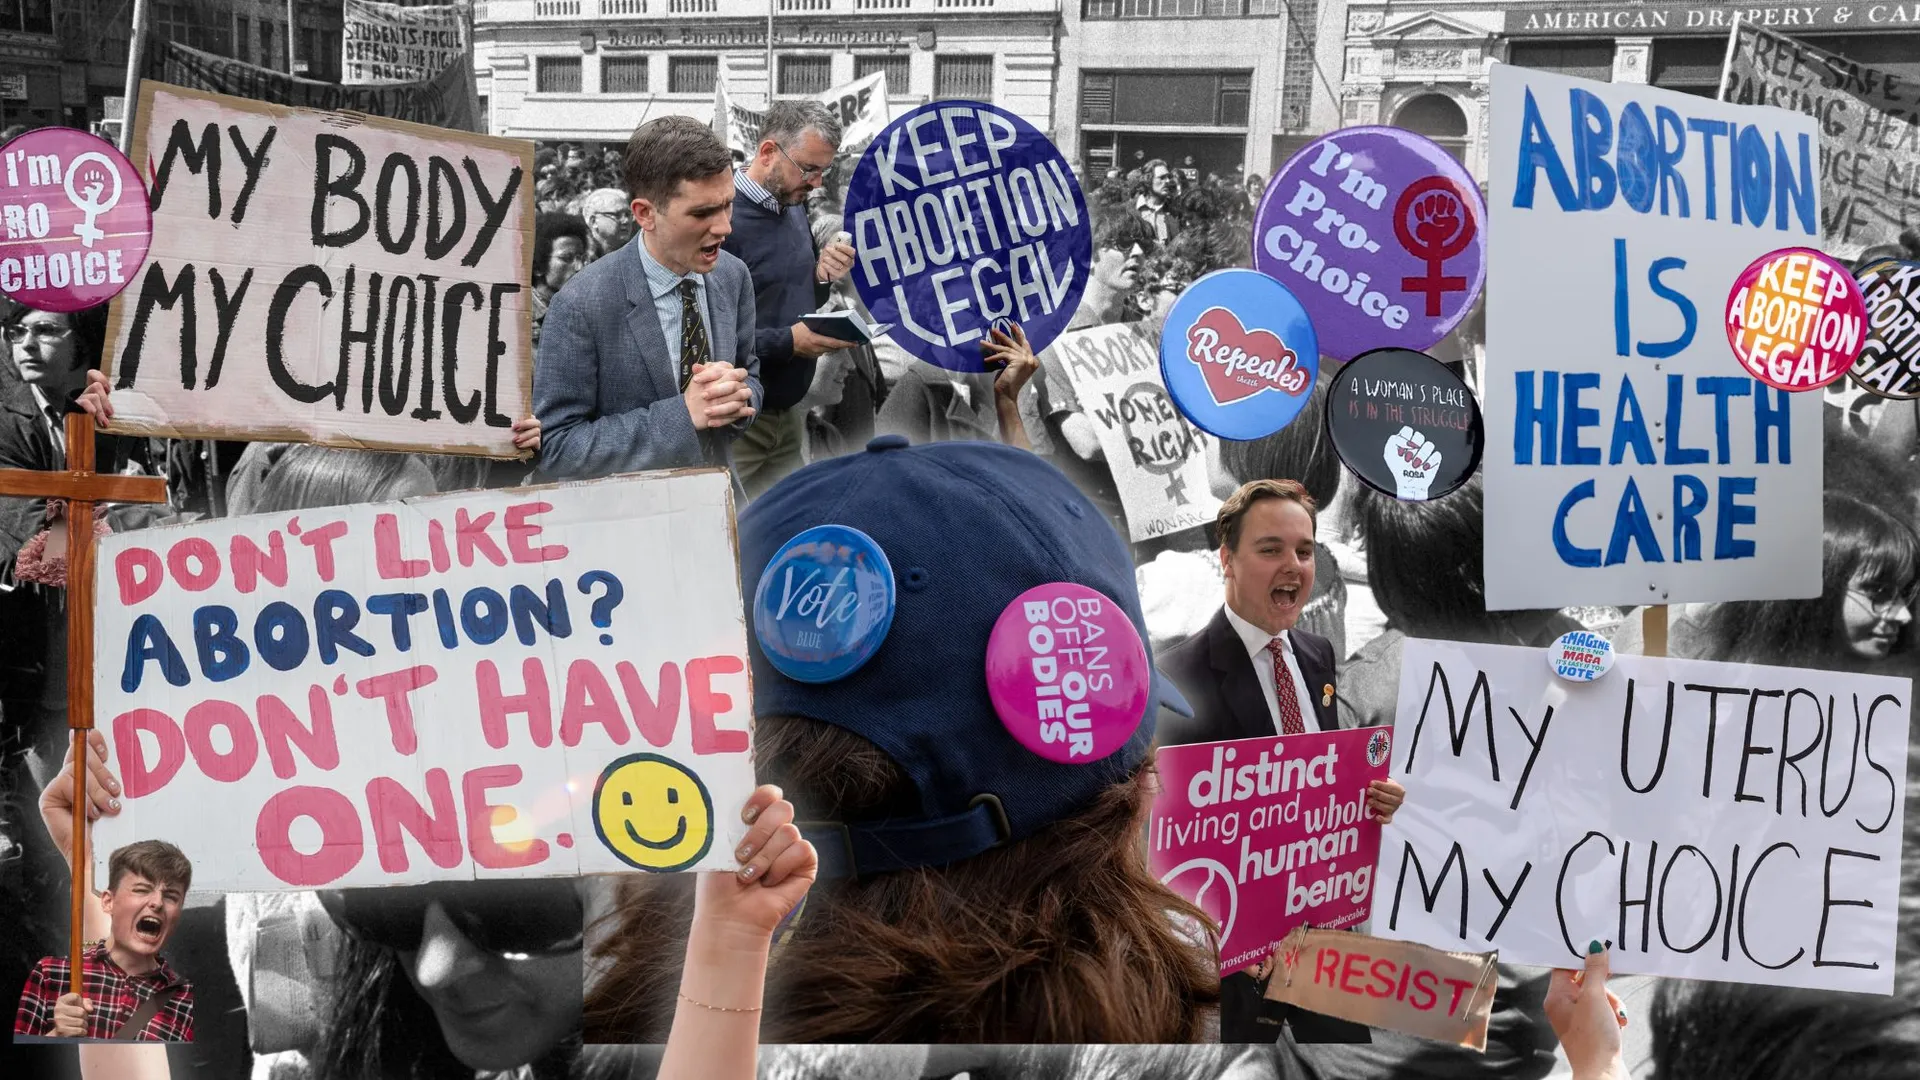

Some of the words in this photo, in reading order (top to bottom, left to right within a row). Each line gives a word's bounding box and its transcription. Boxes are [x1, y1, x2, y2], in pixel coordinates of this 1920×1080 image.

[1525, 11, 1669, 29] AMERICAN
[1834, 7, 1852, 24] &
[346, 41, 399, 63] DEFEND
[406, 48, 425, 66] THE
[346, 62, 362, 79] TO
[6, 150, 62, 187] I'm
[875, 106, 1017, 197] KEEP
[1309, 140, 1387, 210] I'm
[1512, 85, 1817, 235] ABORTION
[0, 203, 50, 239] RO
[151, 118, 277, 229] MY
[311, 134, 523, 267] BODY
[854, 159, 1079, 288] ABORTION
[1285, 180, 1381, 253] Pro-
[0, 250, 125, 292] CHOICE
[891, 240, 1075, 348] LEGAL
[1264, 225, 1409, 329] Choice
[1613, 238, 1698, 359] IS
[1758, 255, 1848, 306] KEEP
[114, 261, 254, 391] MY
[265, 263, 522, 428] CHOICE
[1729, 287, 1860, 356] ABORTION
[1193, 328, 1305, 392] Repealed
[1735, 328, 1837, 385] LEGAL
[1349, 400, 1359, 419] IS
[1366, 402, 1378, 419] IN
[1385, 403, 1404, 423] THE
[1411, 406, 1469, 431] STRUGGLE
[1351, 377, 1359, 395] A
[1365, 378, 1426, 402] WOMAN'S
[1432, 385, 1465, 408] PLACE
[1514, 370, 1791, 466] HEALTH
[1403, 470, 1425, 479] ROSA
[114, 515, 349, 606] DON'T
[373, 501, 569, 581] LIKE
[1552, 474, 1759, 567] CARE
[121, 569, 625, 693] ABORTION?
[775, 566, 863, 630] Vote
[1051, 596, 1084, 667] OFF
[796, 630, 824, 650] BLUE
[1023, 600, 1066, 745] BODIES
[1076, 597, 1113, 692] BANS
[1557, 665, 1594, 681] VOTE
[1562, 650, 1601, 665] MAGA
[1568, 660, 1583, 668] EASY
[1592, 664, 1605, 672] YOU
[112, 665, 438, 799] DON'T
[475, 655, 750, 754] HAVE
[1061, 671, 1094, 758] OUR
[1188, 742, 1339, 808] distinct
[1620, 680, 1902, 834] UTERUS
[256, 764, 573, 887] ONE.
[1156, 812, 1240, 852] living
[1249, 792, 1301, 831] and
[1238, 826, 1359, 885] human
[1285, 862, 1373, 917] being
[1556, 830, 1882, 970] CHOICE
[1314, 948, 1473, 1017] RESIST
